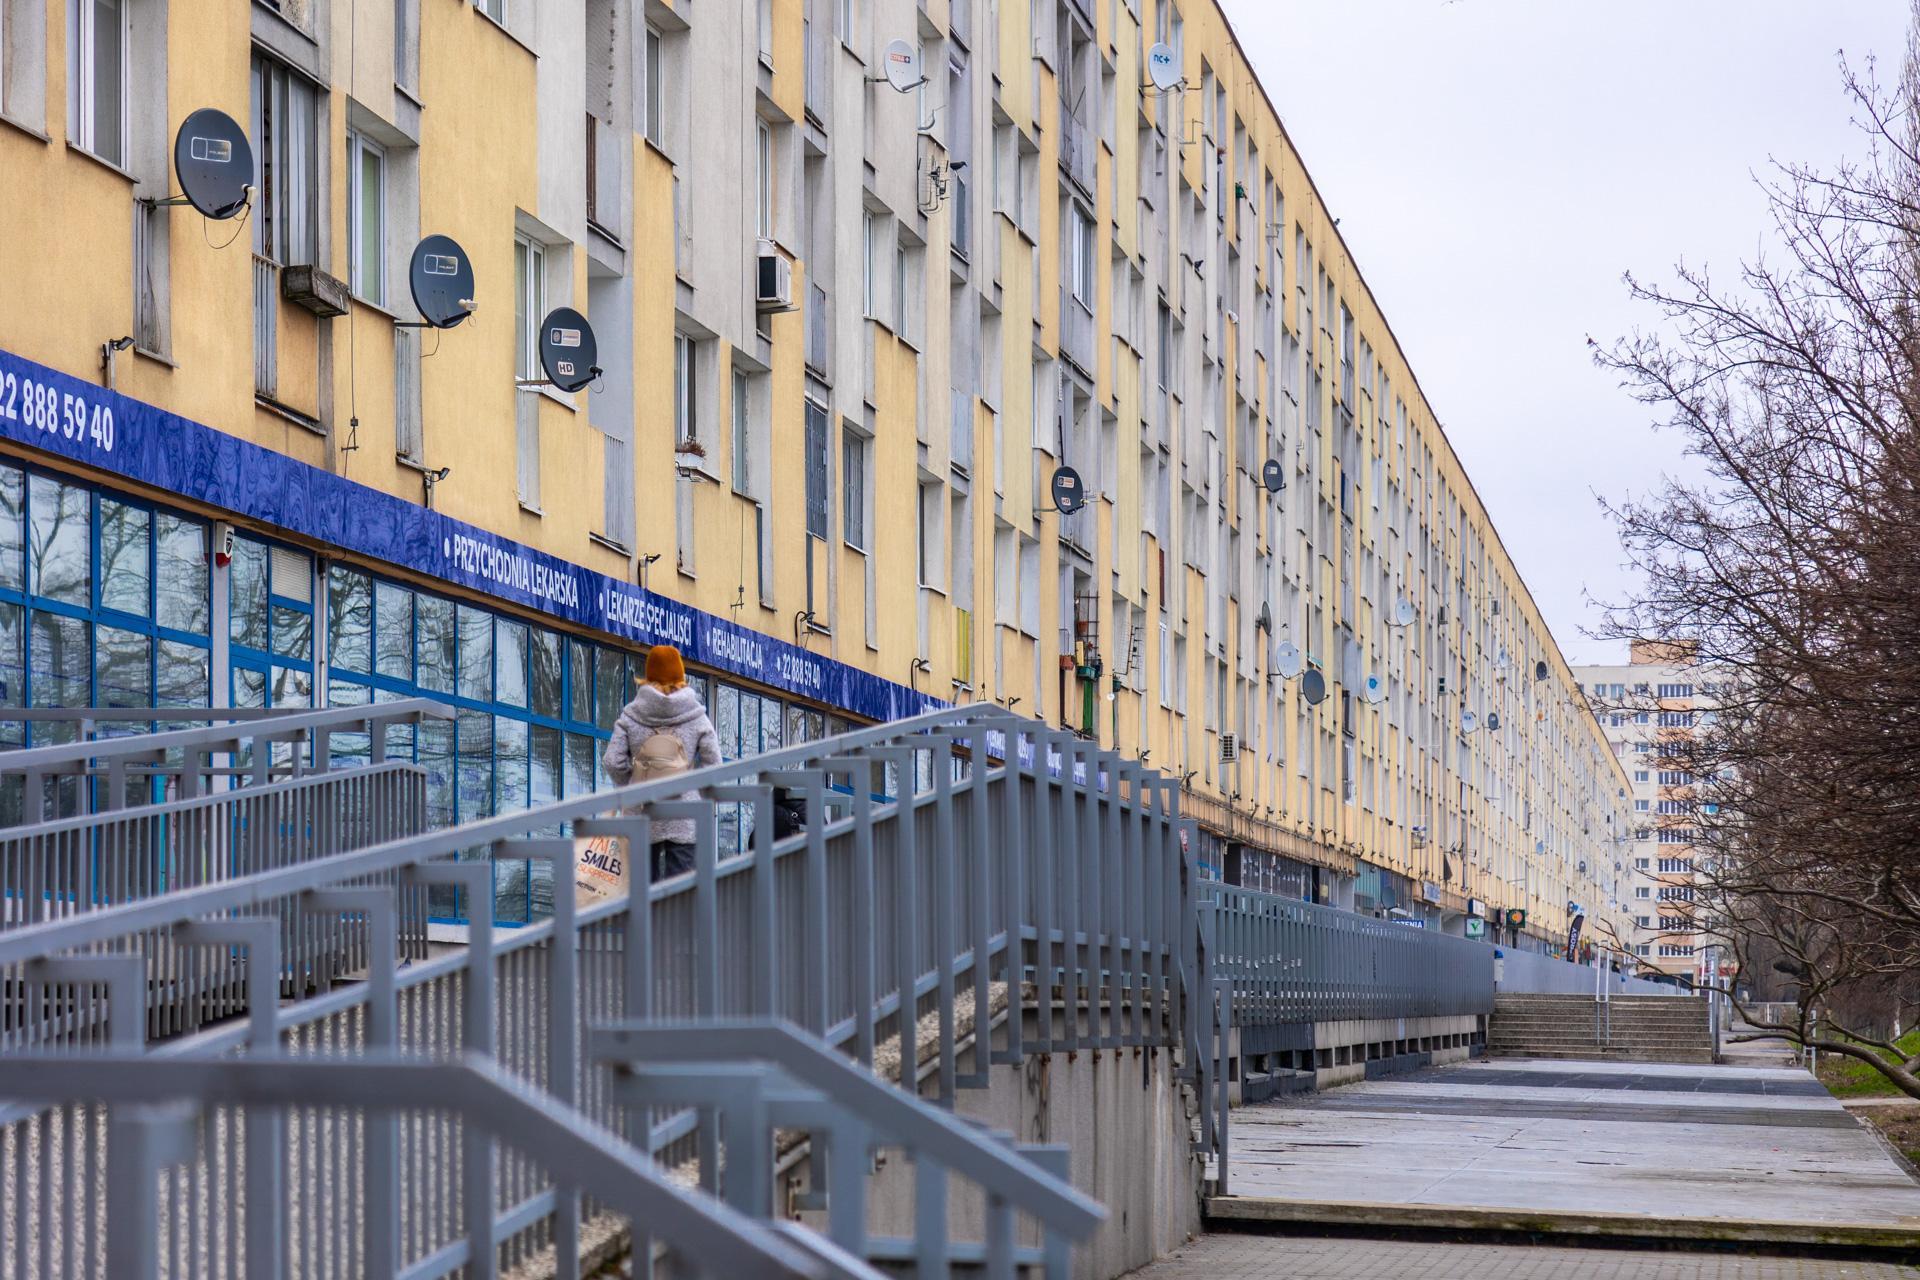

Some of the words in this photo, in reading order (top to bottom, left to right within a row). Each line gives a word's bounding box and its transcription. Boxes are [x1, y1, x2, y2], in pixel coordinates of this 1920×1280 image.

[559, 363, 573, 373] HD
[22, 378, 58, 434] 888
[63, 393, 86, 442] 59
[90, 404, 114, 452] 40
[454, 533, 531, 593] PRZYCHODNIA
[530, 561, 580, 610] LEKARSKA
[606, 588, 646, 631] LEKARZE
[712, 626, 764, 671] REHABILITACJA
[782, 652, 791, 681] 22
[791, 655, 804, 685] 888
[804, 660, 812, 687] 59
[812, 663, 821, 690] 40
[580, 849, 622, 877] SMILES
